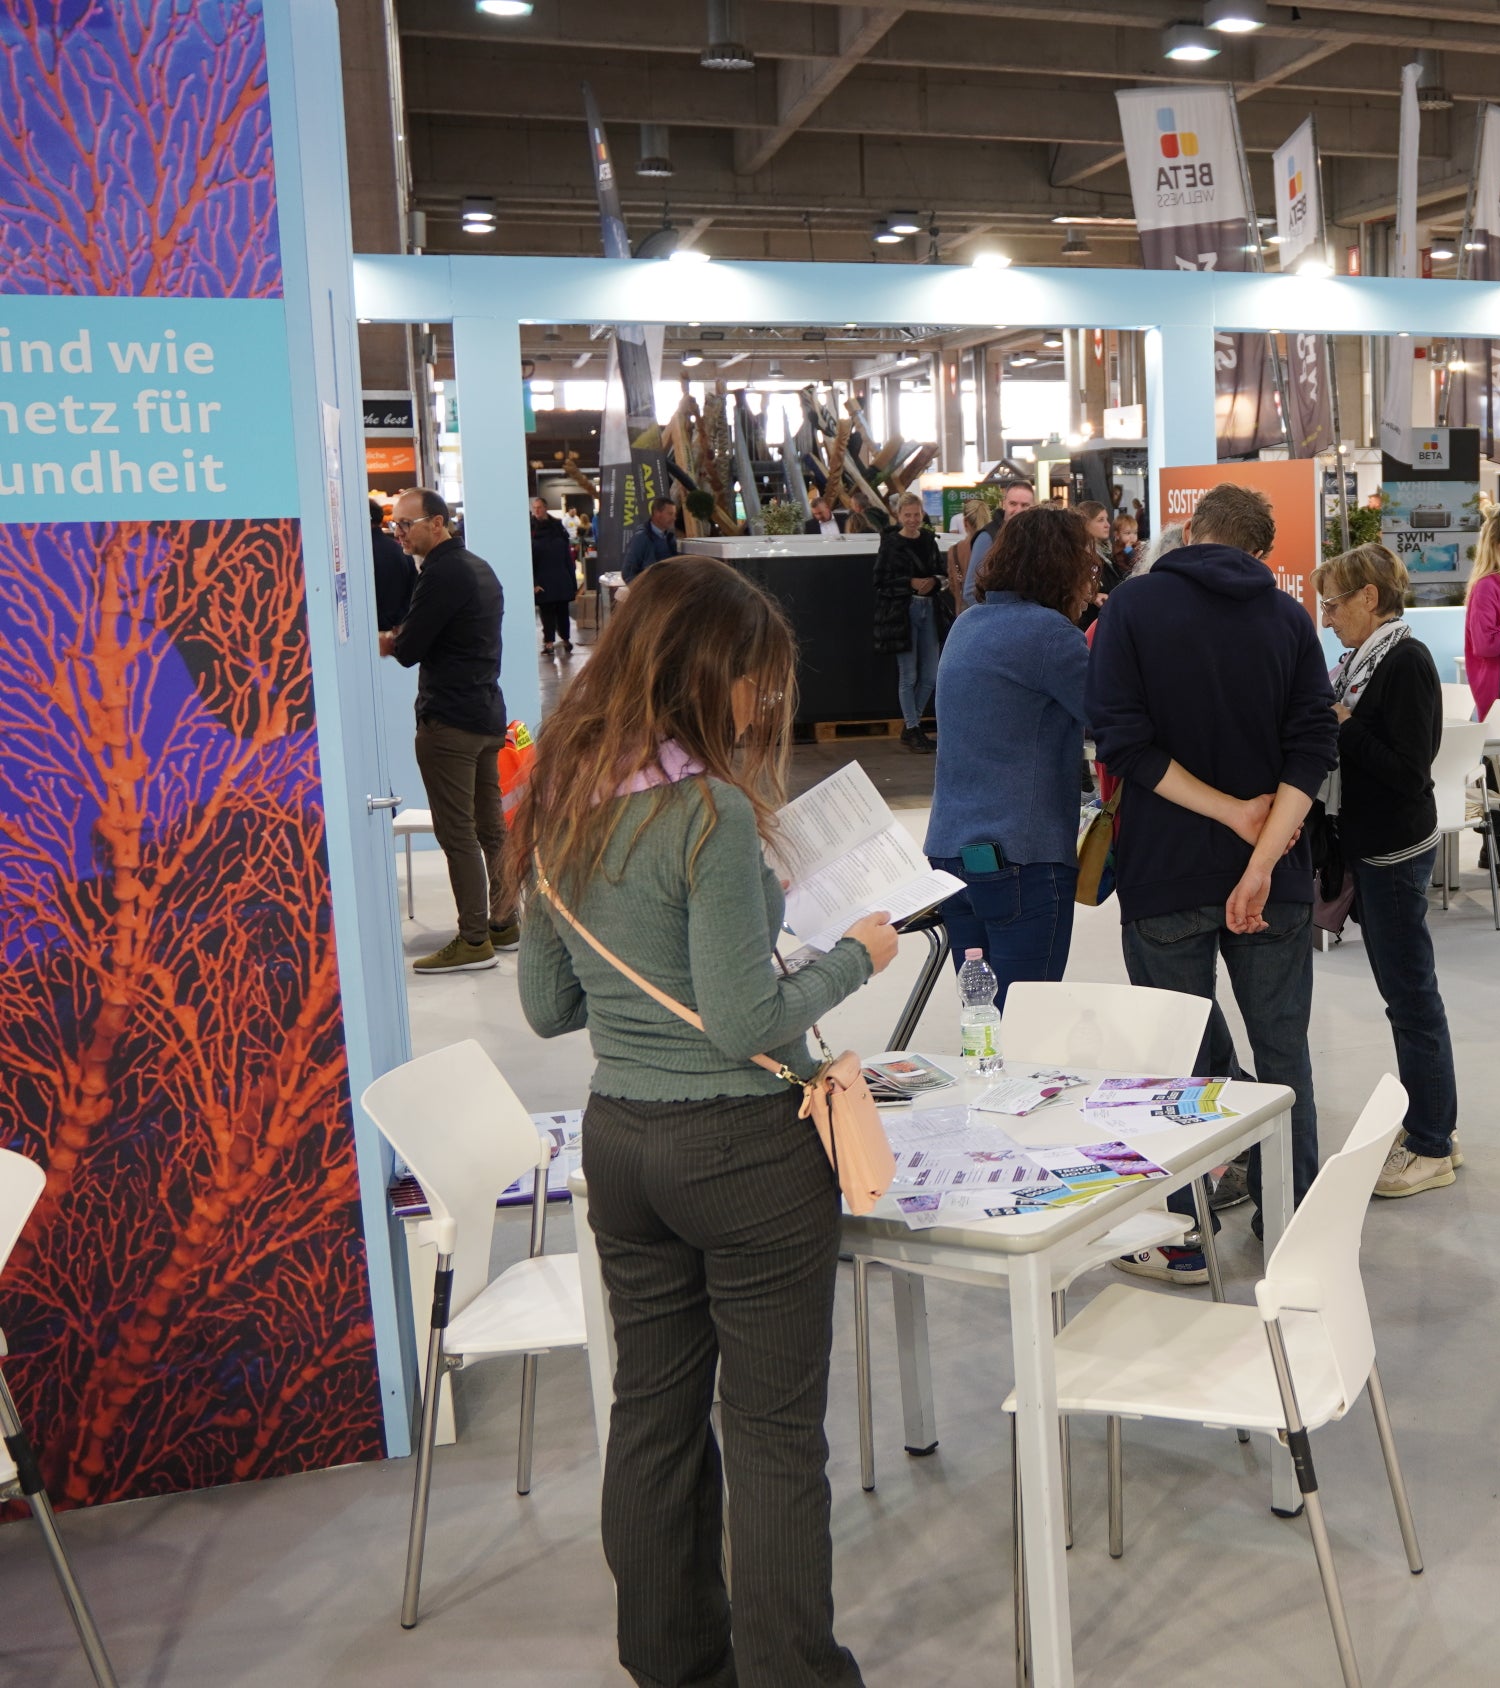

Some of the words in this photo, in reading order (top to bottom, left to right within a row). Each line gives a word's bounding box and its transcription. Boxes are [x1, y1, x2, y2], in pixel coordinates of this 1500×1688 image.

[107, 328, 215, 375] wie
[133, 388, 222, 434] für
[383, 412, 409, 425] best
[1419, 451, 1443, 460] BETA
[1396, 531, 1435, 543] SWIM
[1396, 542, 1423, 553] SPA
[1273, 565, 1304, 603] ÜHE
